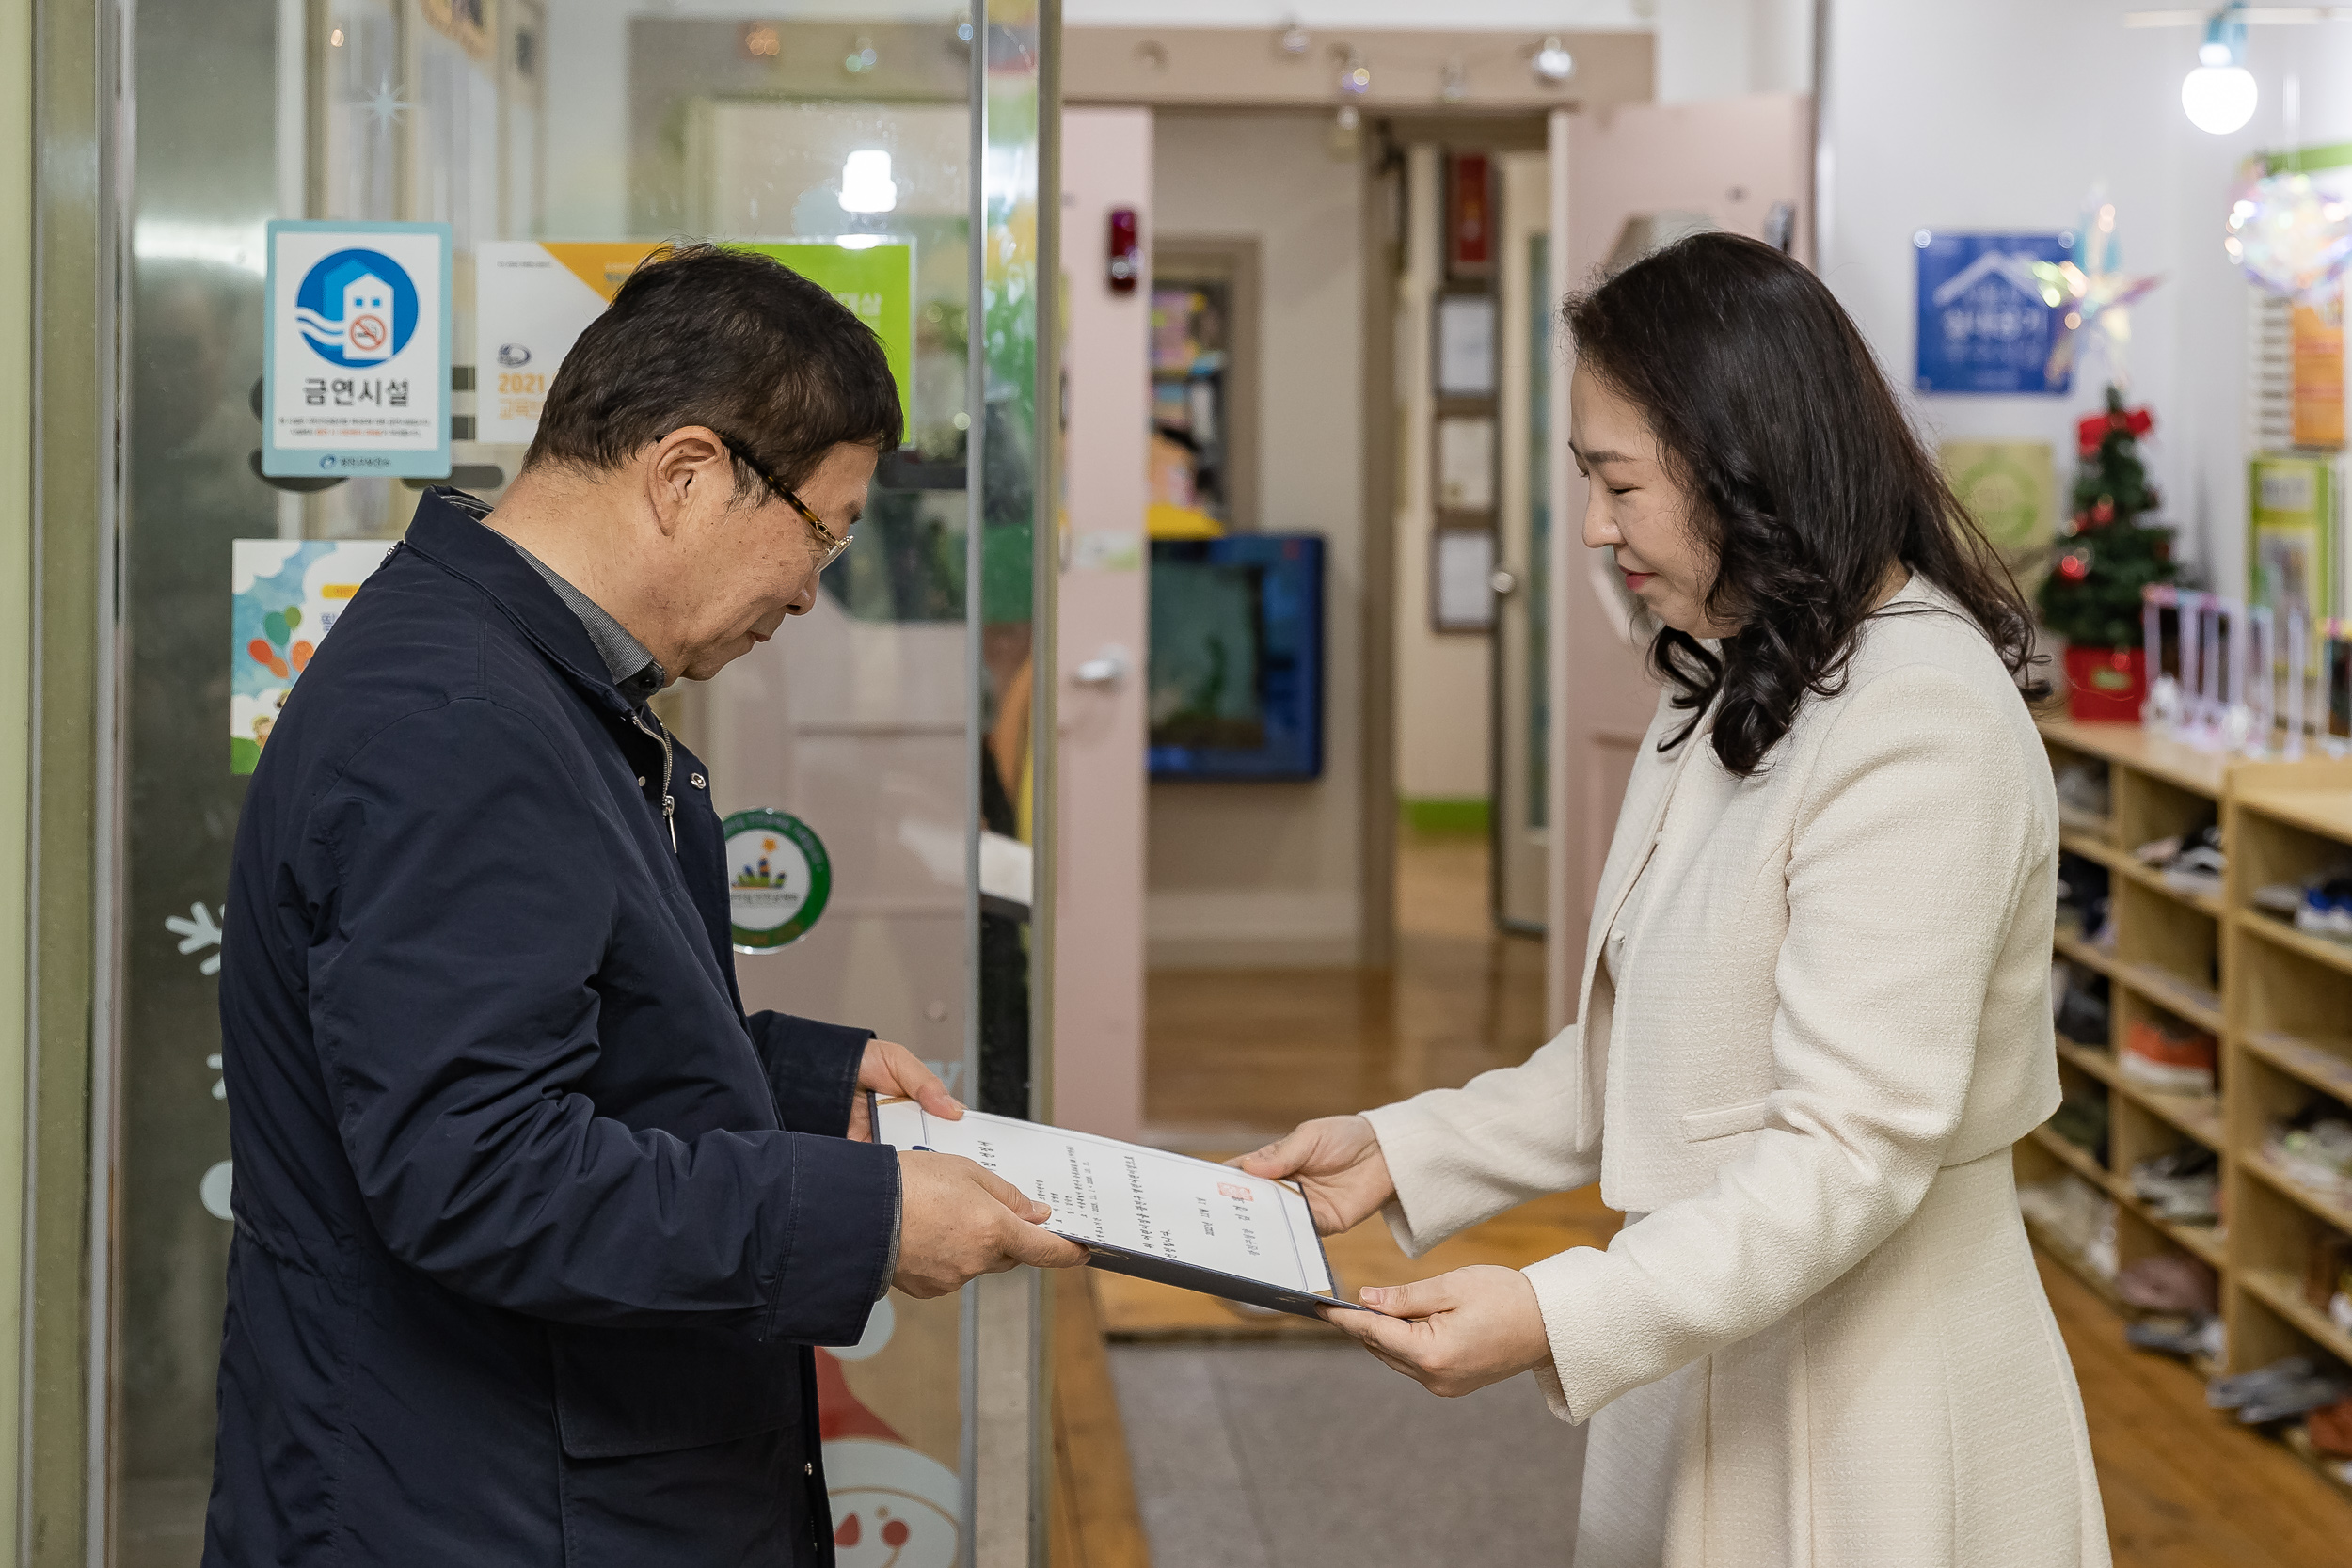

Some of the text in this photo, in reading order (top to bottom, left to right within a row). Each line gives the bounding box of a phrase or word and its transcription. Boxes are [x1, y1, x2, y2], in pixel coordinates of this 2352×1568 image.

[302, 377, 409, 407] 금연시설
[498, 372, 545, 394] 2021
[1123, 1156, 1143, 1193] 열린어린이집으로
[1133, 1196, 1147, 1212] 광진구
[1136, 1213, 1153, 1240] 어린이집을
[1160, 1230, 1177, 1258] 선정합니다.
[1242, 1228, 1260, 1256] 광진구청장
